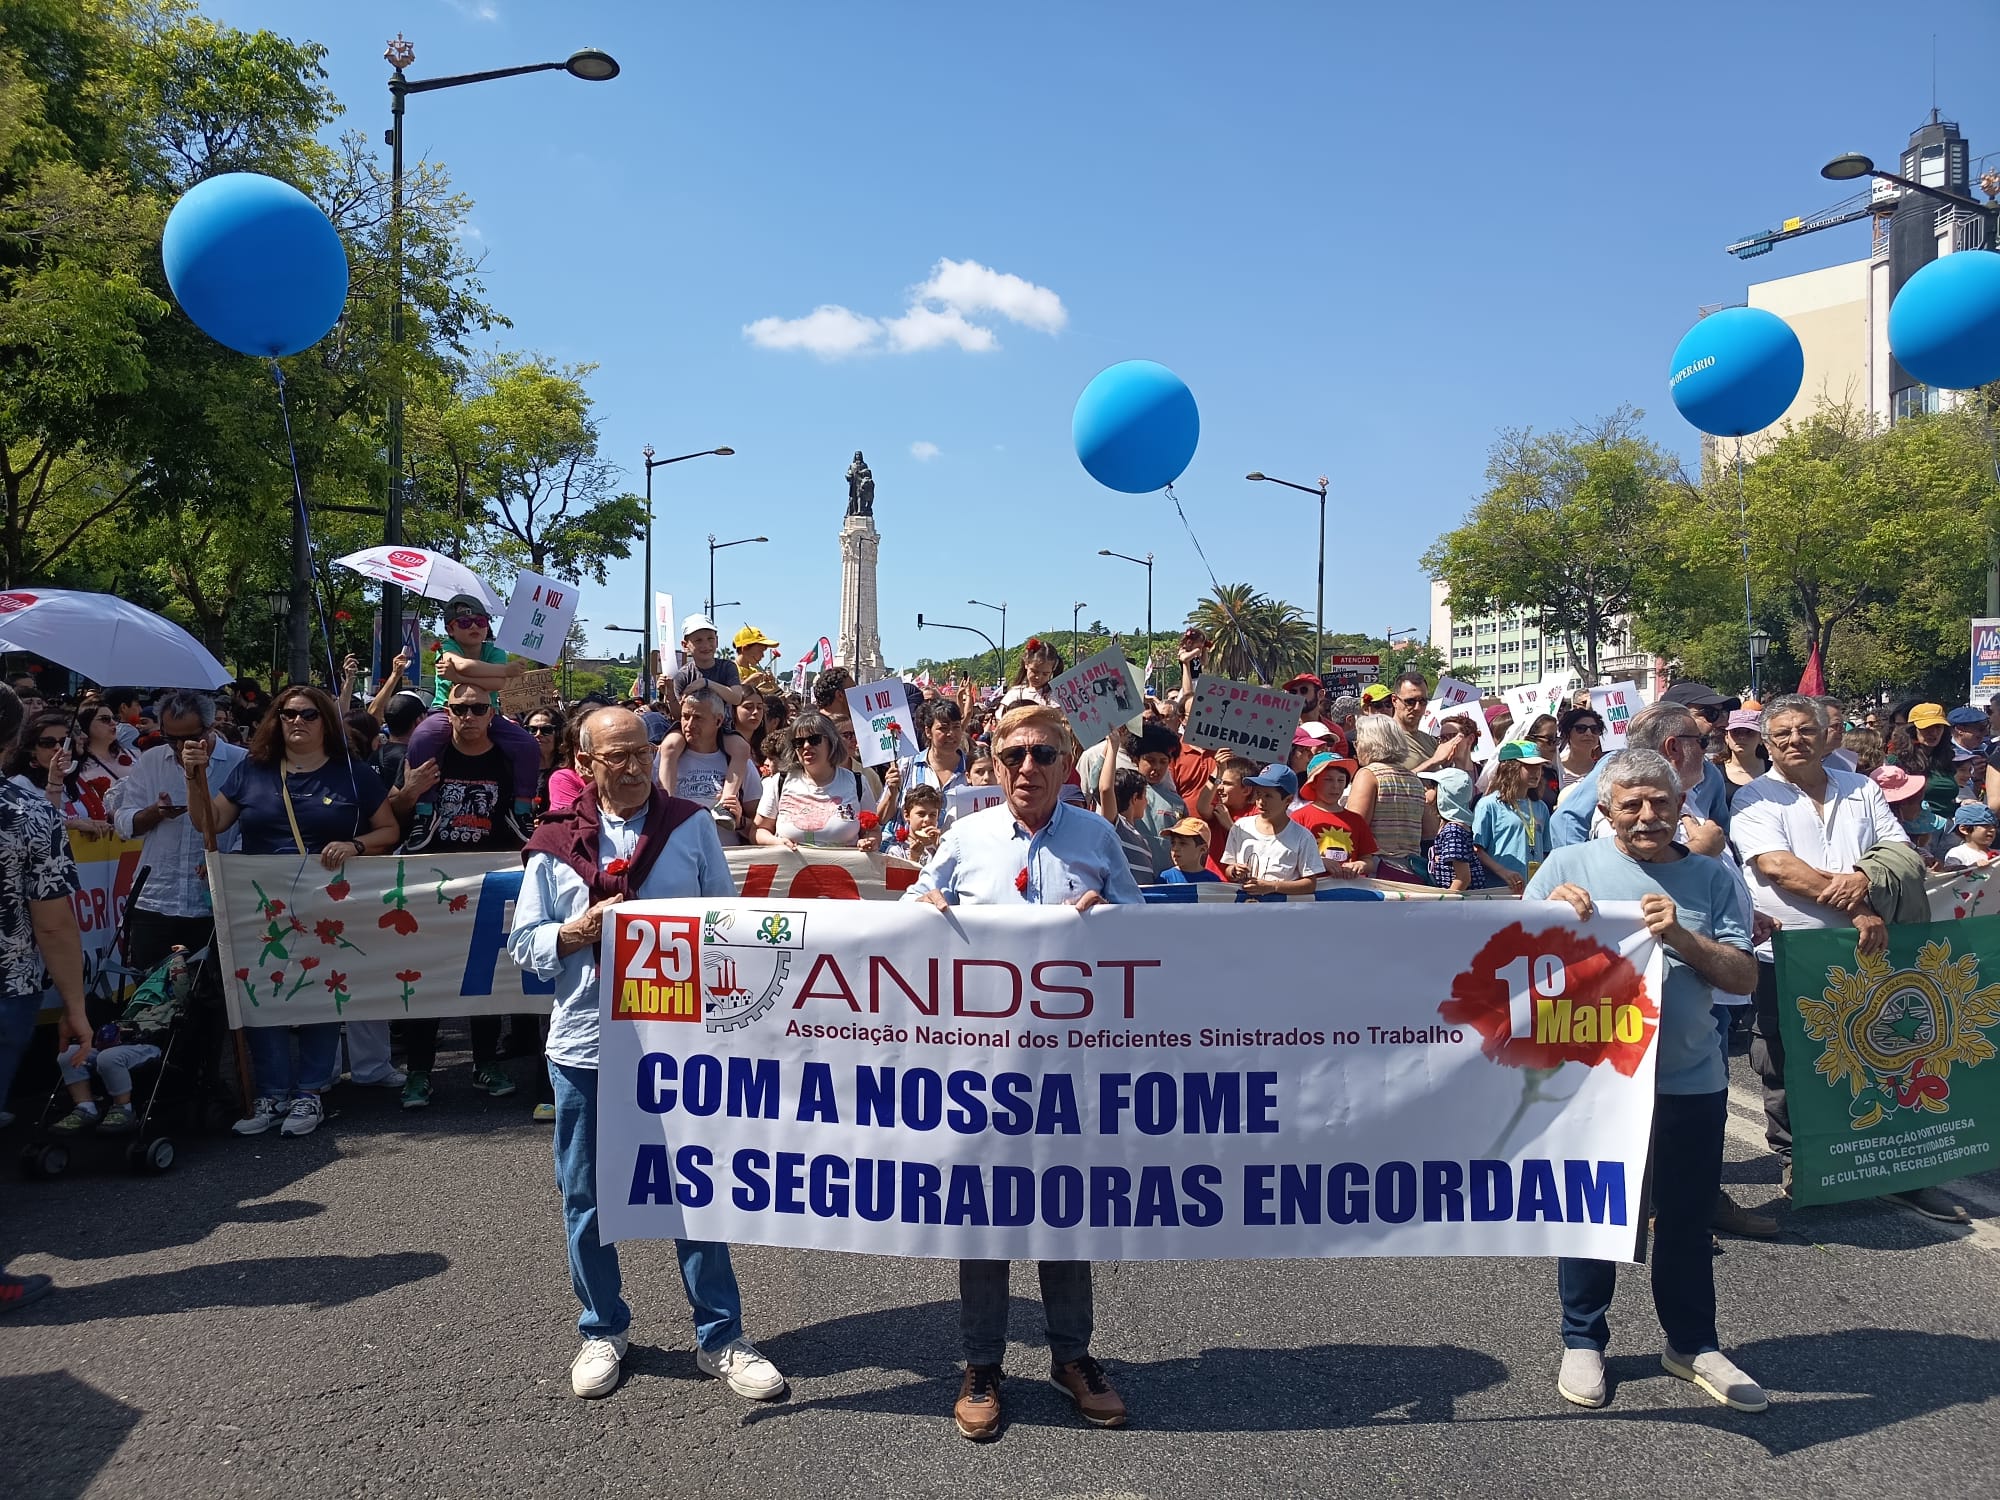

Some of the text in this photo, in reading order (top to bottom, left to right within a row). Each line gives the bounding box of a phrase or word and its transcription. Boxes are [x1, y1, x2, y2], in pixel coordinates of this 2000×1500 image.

[1675, 355, 1716, 384] OPERÁRIO
[391, 552, 424, 566] STOP
[532, 585, 564, 610] A VOZ
[531, 608, 547, 629] faz
[521, 629, 545, 650] abril
[1340, 656, 1371, 664] ATENÇÃO
[1055, 683, 1067, 699] 25
[1067, 677, 1081, 696] DE
[1081, 661, 1109, 684] ABRIL
[864, 690, 893, 713] A VOZ
[1207, 683, 1292, 713] 25 DE ABRIL
[1445, 686, 1468, 704] A VOZ
[1518, 690, 1537, 704] A VOZ
[1605, 691, 1627, 707] A VOZ
[1607, 705, 1630, 722] CANTA
[1612, 720, 1628, 736] ABR
[880, 734, 898, 751] abrl
[1195, 721, 1280, 752] LIBERDADE
[973, 797, 979, 812] A
[625, 919, 693, 982] 25
[619, 980, 693, 1015] Abril
[792, 953, 1161, 1020] ANDST
[785, 1019, 1464, 1049] Associação Nacional dos Deficientes Sinistrados no Trabalho
[1536, 997, 1644, 1044] Maio
[636, 1052, 1280, 1136] COM A NOSSA FOME
[1829, 1118, 1976, 1156] CONFEDERAÇÃO PORTUGUESA
[1855, 1135, 1956, 1166] DAS COLECTIVIDADES
[1821, 1142, 1990, 1187] DE CULTURA, RECREIO E DESPORTO
[628, 1144, 1628, 1228] AS SEGURADORAS ENGORDAM
